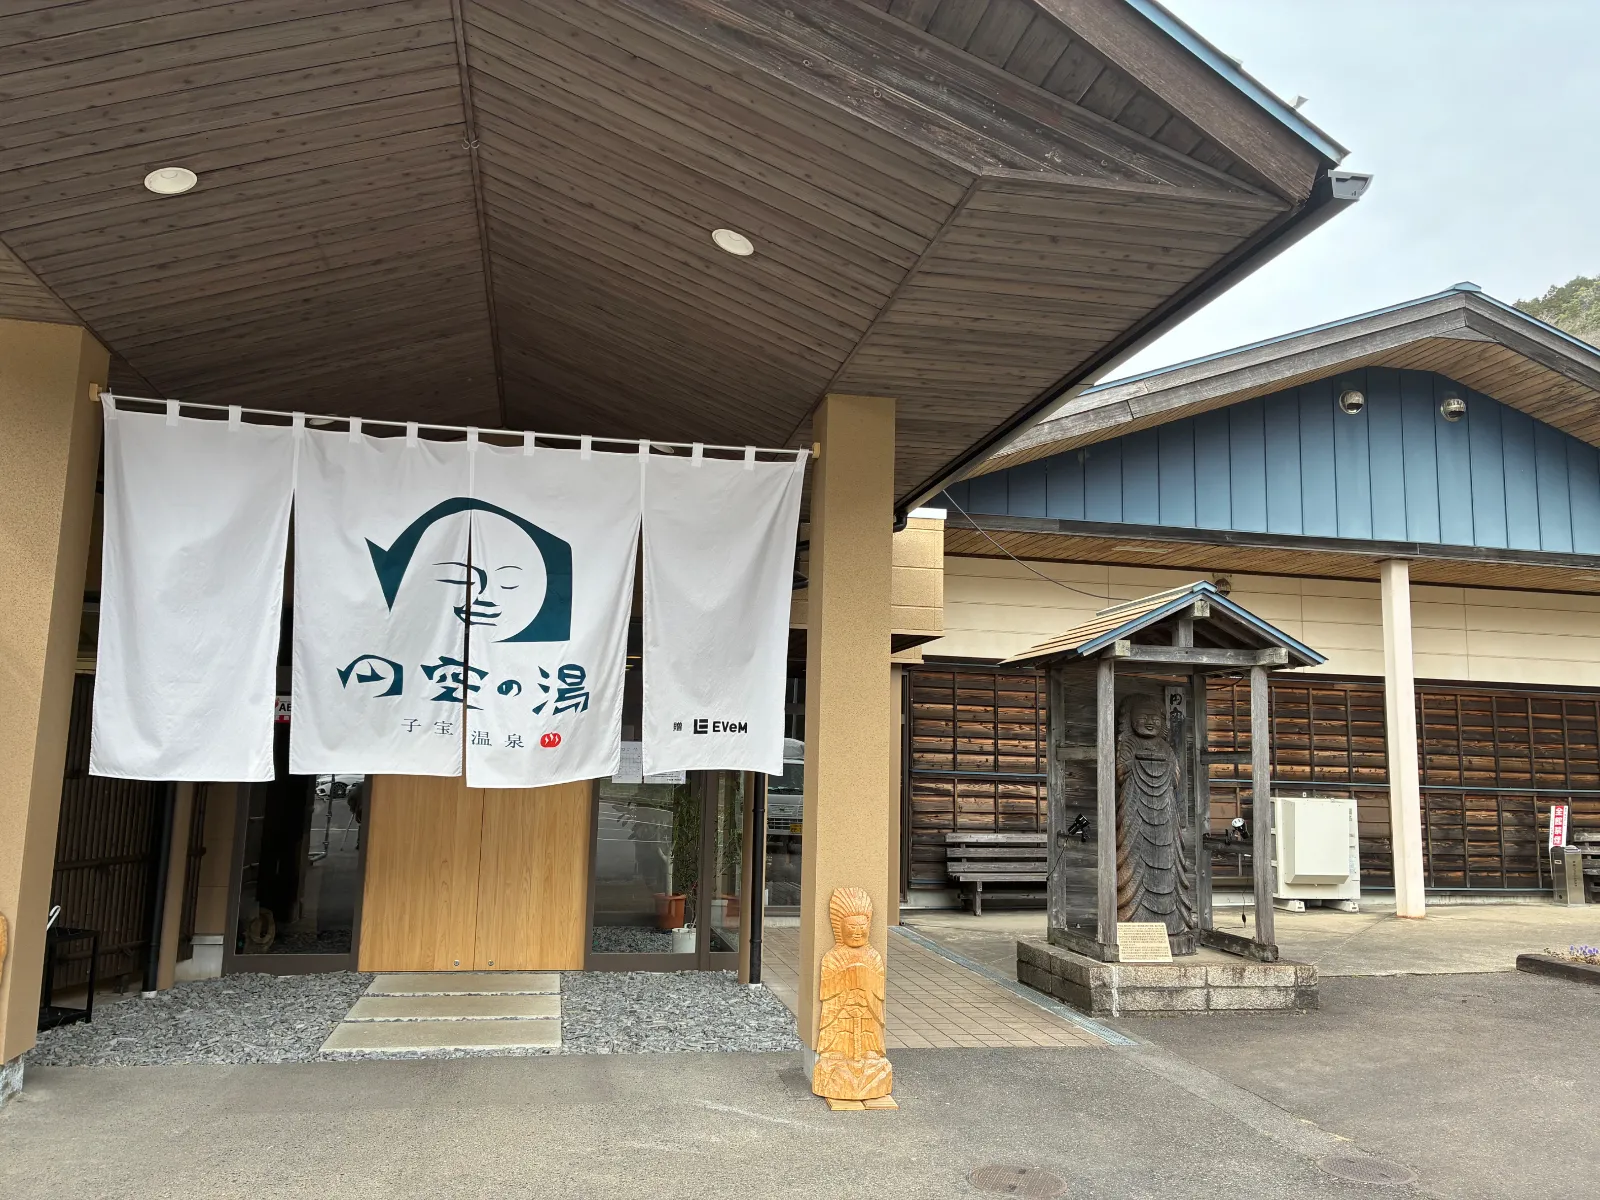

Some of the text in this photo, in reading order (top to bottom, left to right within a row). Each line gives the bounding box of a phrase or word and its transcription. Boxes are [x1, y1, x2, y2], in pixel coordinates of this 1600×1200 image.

[279, 702, 292, 712] AE
[401, 717, 525, 749] 子宝温泉
[712, 721, 748, 734] EVeM
